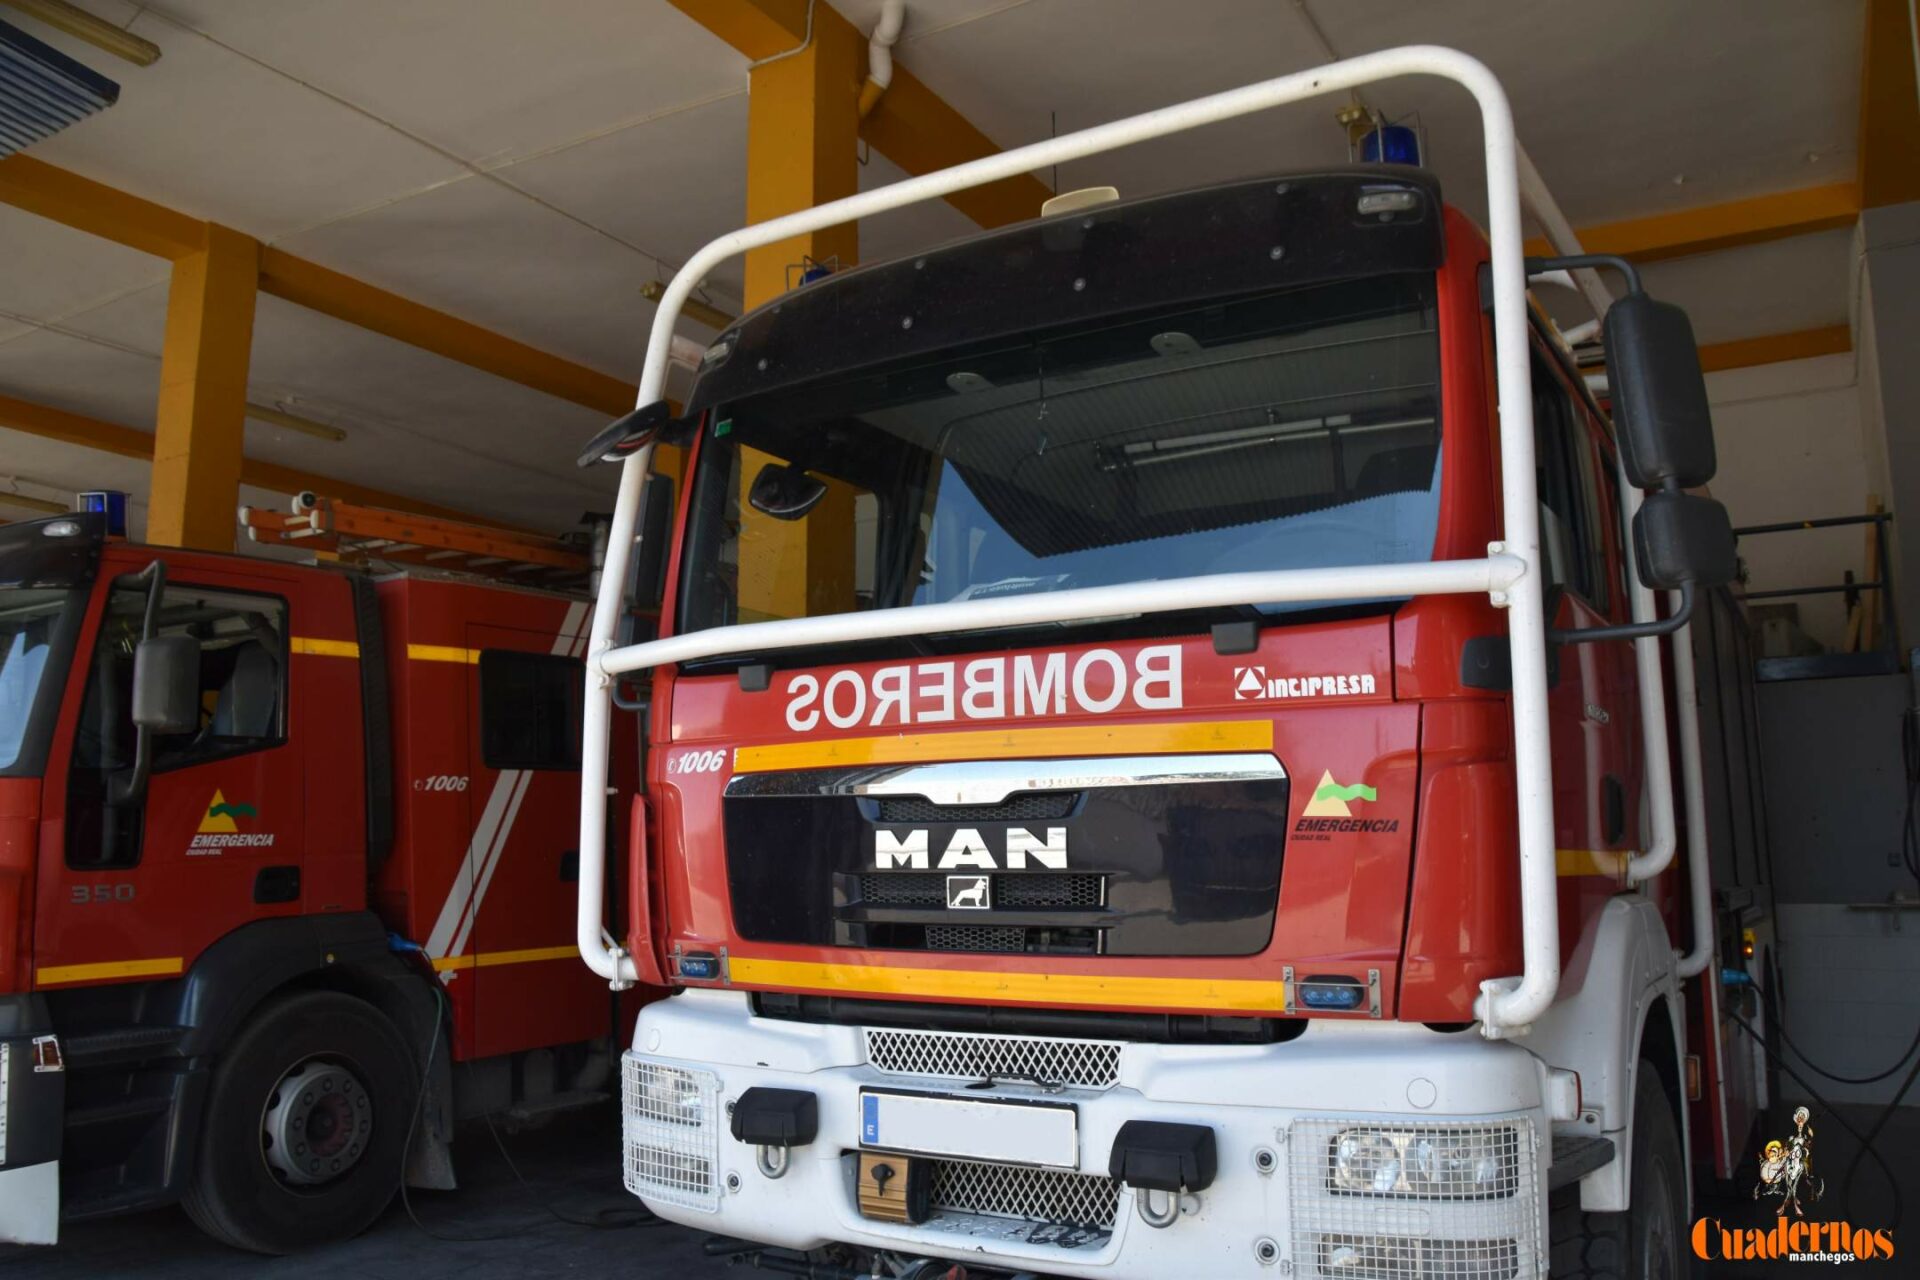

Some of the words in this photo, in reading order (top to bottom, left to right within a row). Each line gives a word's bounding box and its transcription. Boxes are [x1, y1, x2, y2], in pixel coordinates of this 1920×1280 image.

[677, 749, 727, 774] 1006
[424, 775, 469, 791] 1006
[1295, 819, 1399, 832] EMERGENCIA
[190, 834, 274, 848] EMERGENCIA
[875, 827, 1068, 869] MAN
[71, 884, 136, 904] 350
[866, 1124, 875, 1136] E
